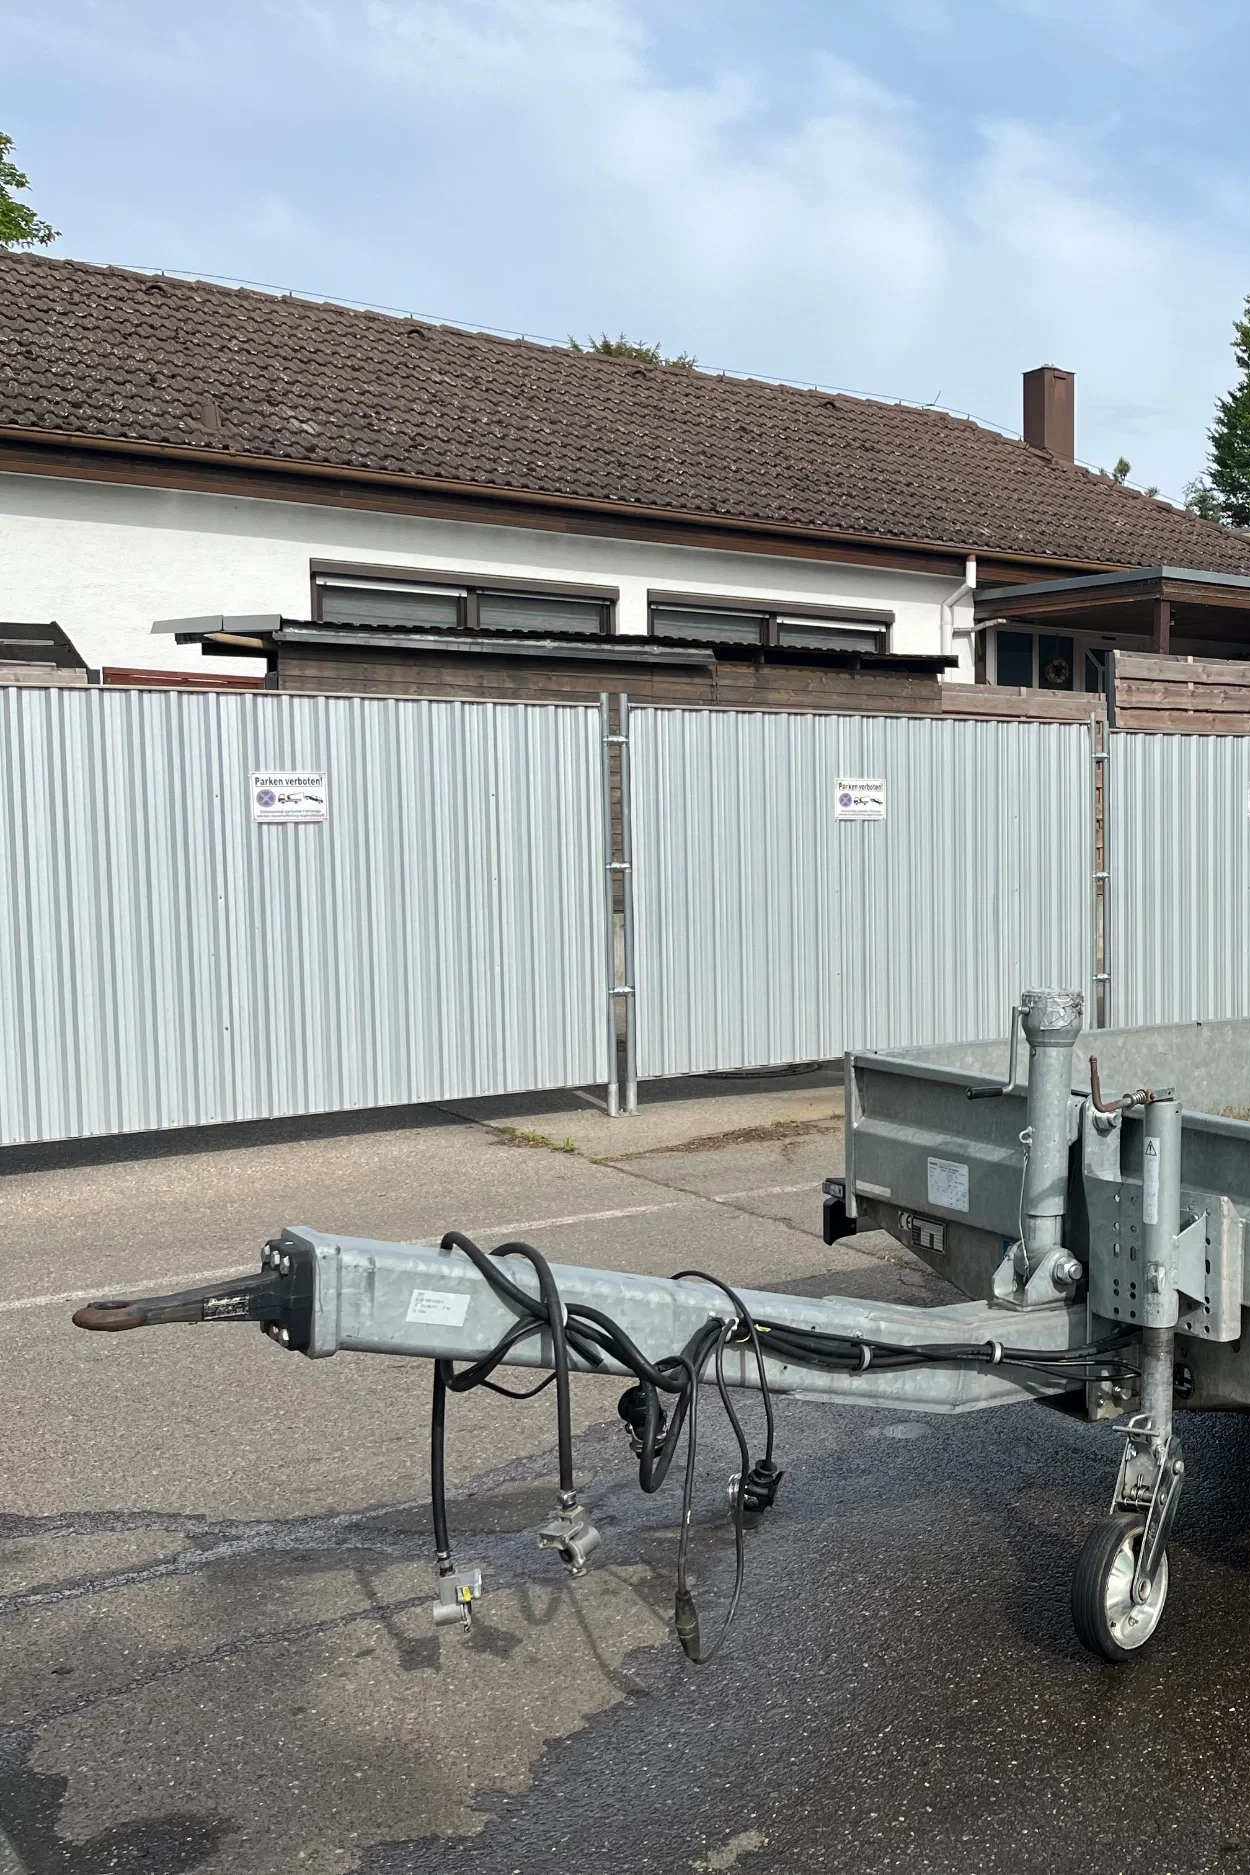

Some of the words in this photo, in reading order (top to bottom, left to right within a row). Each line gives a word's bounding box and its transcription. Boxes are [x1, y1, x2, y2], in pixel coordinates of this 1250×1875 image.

[254, 777, 283, 786] Parken
[285, 777, 323, 786] verboten!
[838, 782, 858, 790] Parken
